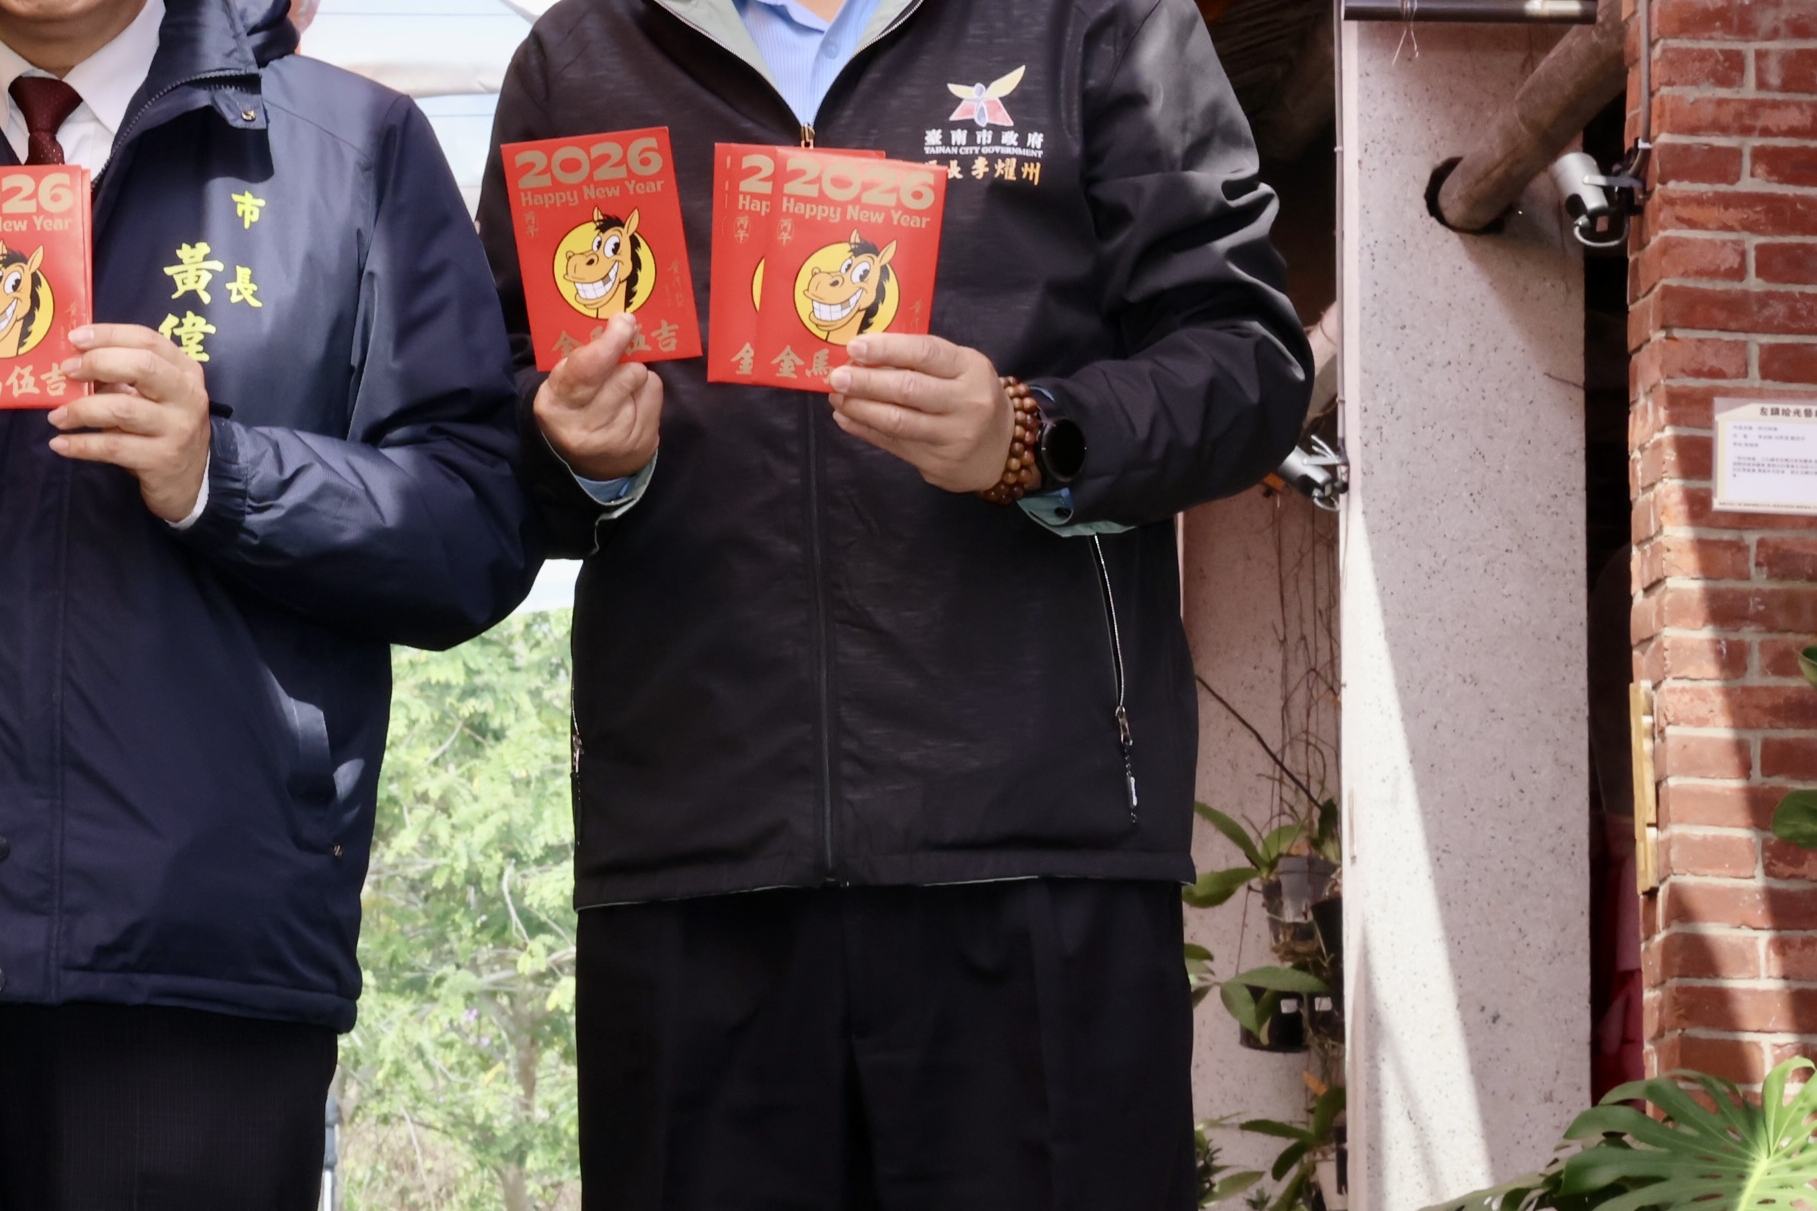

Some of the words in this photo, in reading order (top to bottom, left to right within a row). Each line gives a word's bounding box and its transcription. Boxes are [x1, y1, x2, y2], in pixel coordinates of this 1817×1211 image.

[924, 128, 1044, 149] 臺南市政府
[924, 145, 958, 155] TAINAN
[959, 146, 980, 155] CITY
[981, 145, 1044, 159] GOVERNMENT
[514, 137, 663, 189] 2026
[520, 189, 579, 209] Happy
[583, 184, 620, 200] New
[624, 178, 665, 195] Year
[783, 156, 935, 210] 2026
[738, 194, 771, 216] Hap
[782, 197, 842, 223] Happy
[846, 204, 885, 225] New
[890, 209, 931, 229] Year
[32, 214, 72, 232] Year
[225, 190, 267, 308] 市長
[769, 344, 855, 385] 金馬
